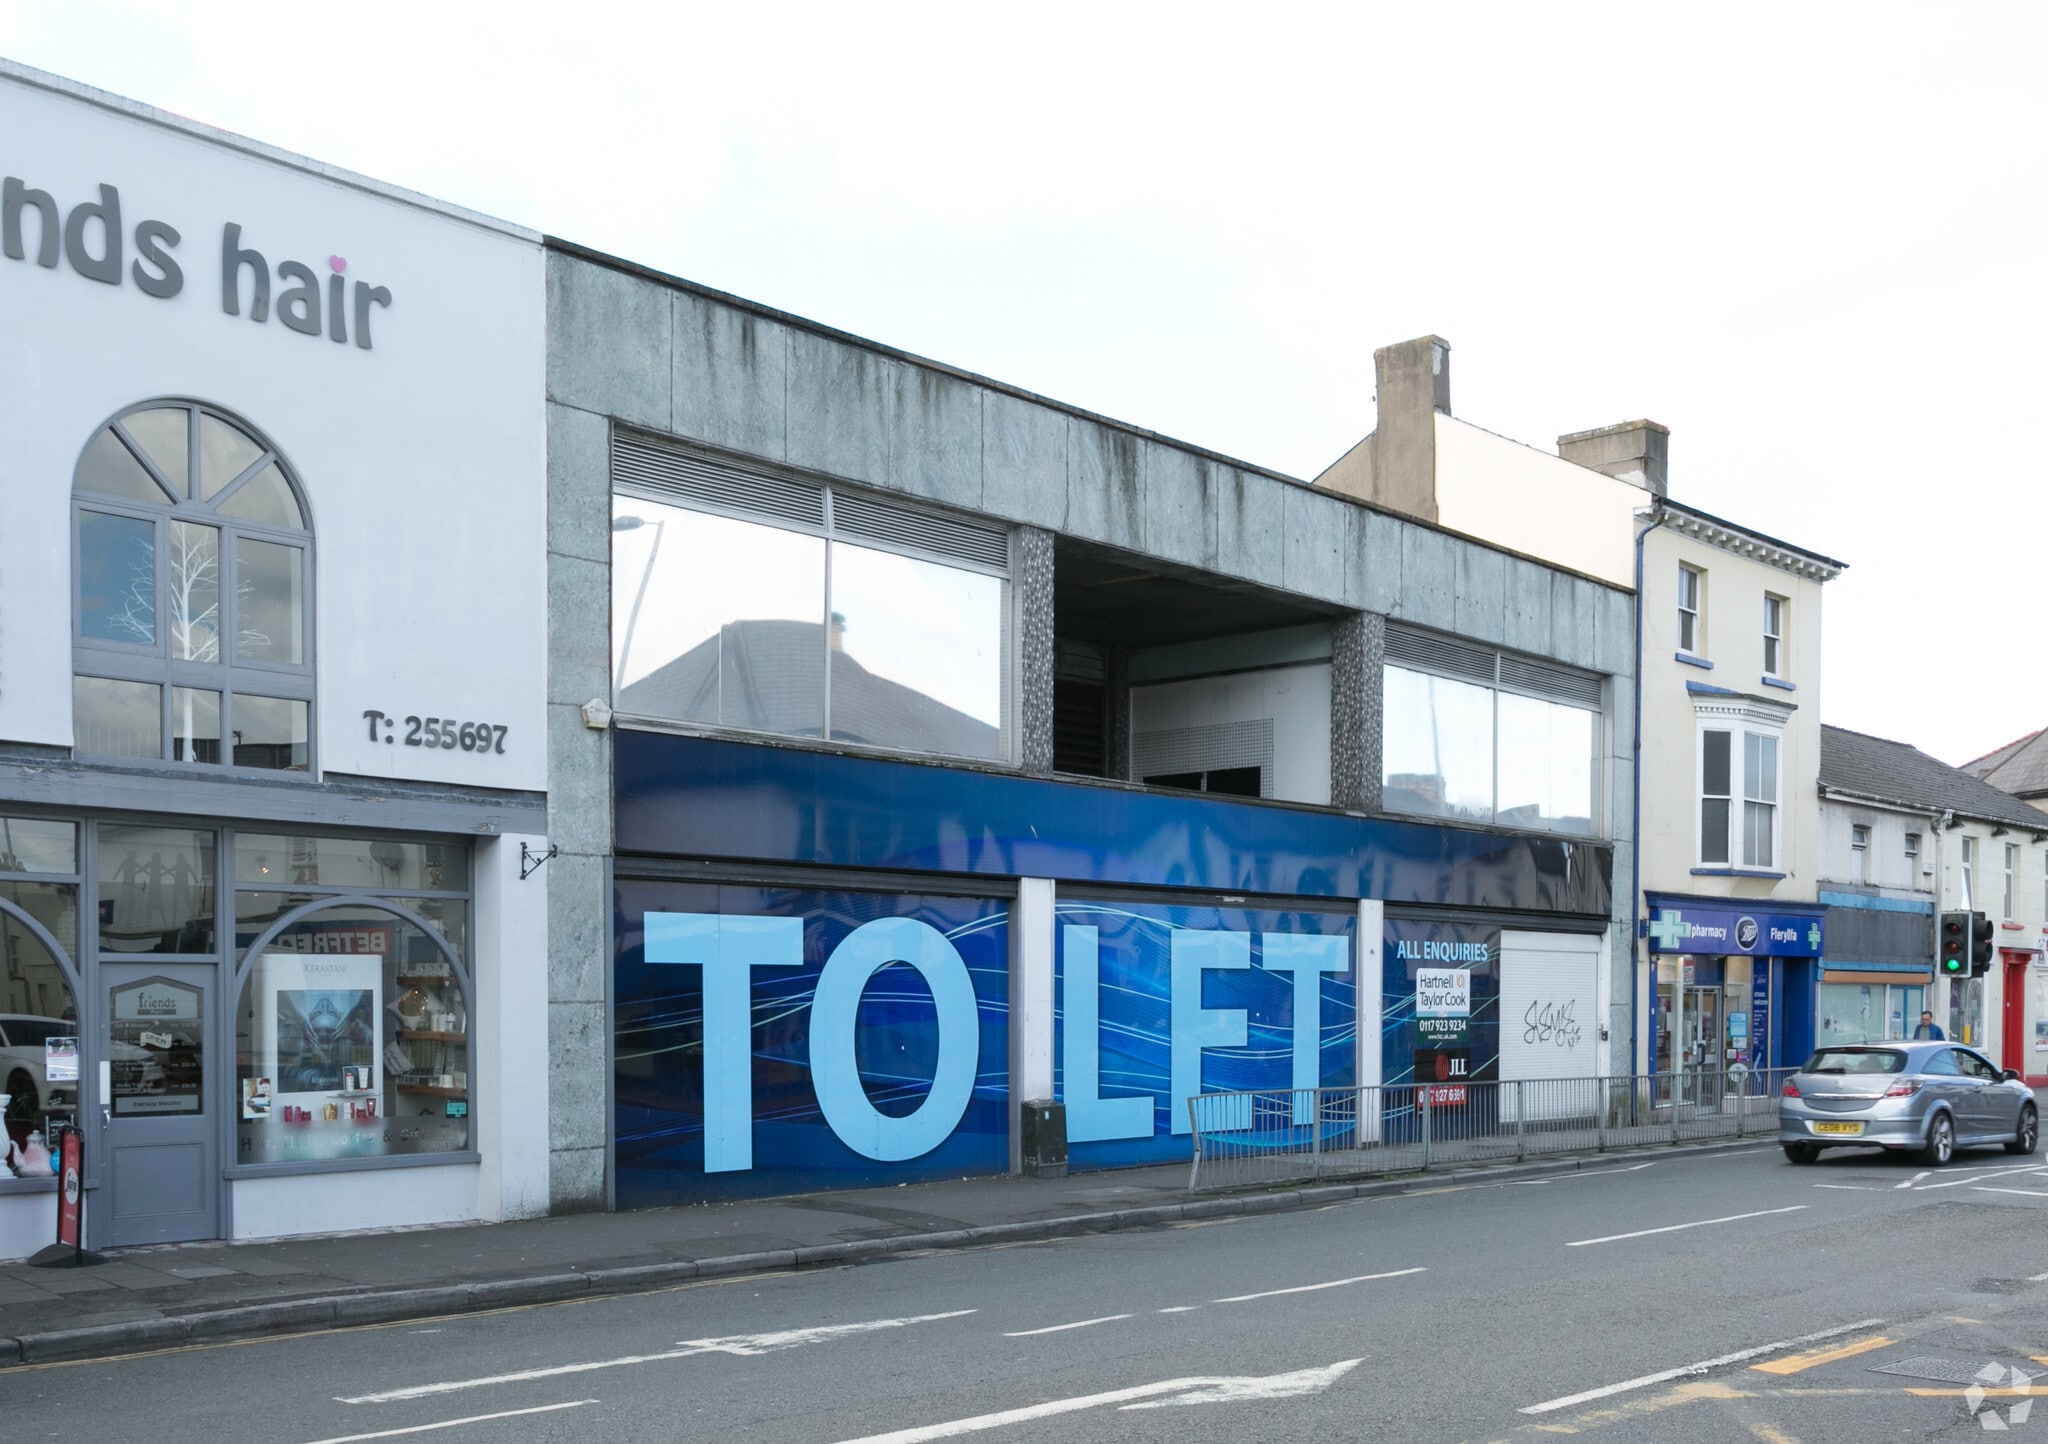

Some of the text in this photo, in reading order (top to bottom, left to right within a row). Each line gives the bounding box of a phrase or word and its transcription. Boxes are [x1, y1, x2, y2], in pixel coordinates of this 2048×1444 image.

[222, 222, 392, 349] hair
[362, 710, 509, 755] T: 255697
[1691, 923, 1727, 940] pharmacy
[1770, 927, 1797, 943] Fferyllfa
[1397, 939, 1488, 963] ALL ENQUIRIES
[1419, 973, 1454, 989] Hartnell
[137, 991, 177, 1008] friends
[1419, 991, 1467, 1009] Taylor Cook
[1419, 1019, 1467, 1032] 0117 923 9234
[145, 1033, 167, 1044] OPEN
[643, 911, 1349, 1173] TO LET
[1448, 1058, 1468, 1076] JLL
[382, 1128, 393, 1143] &
